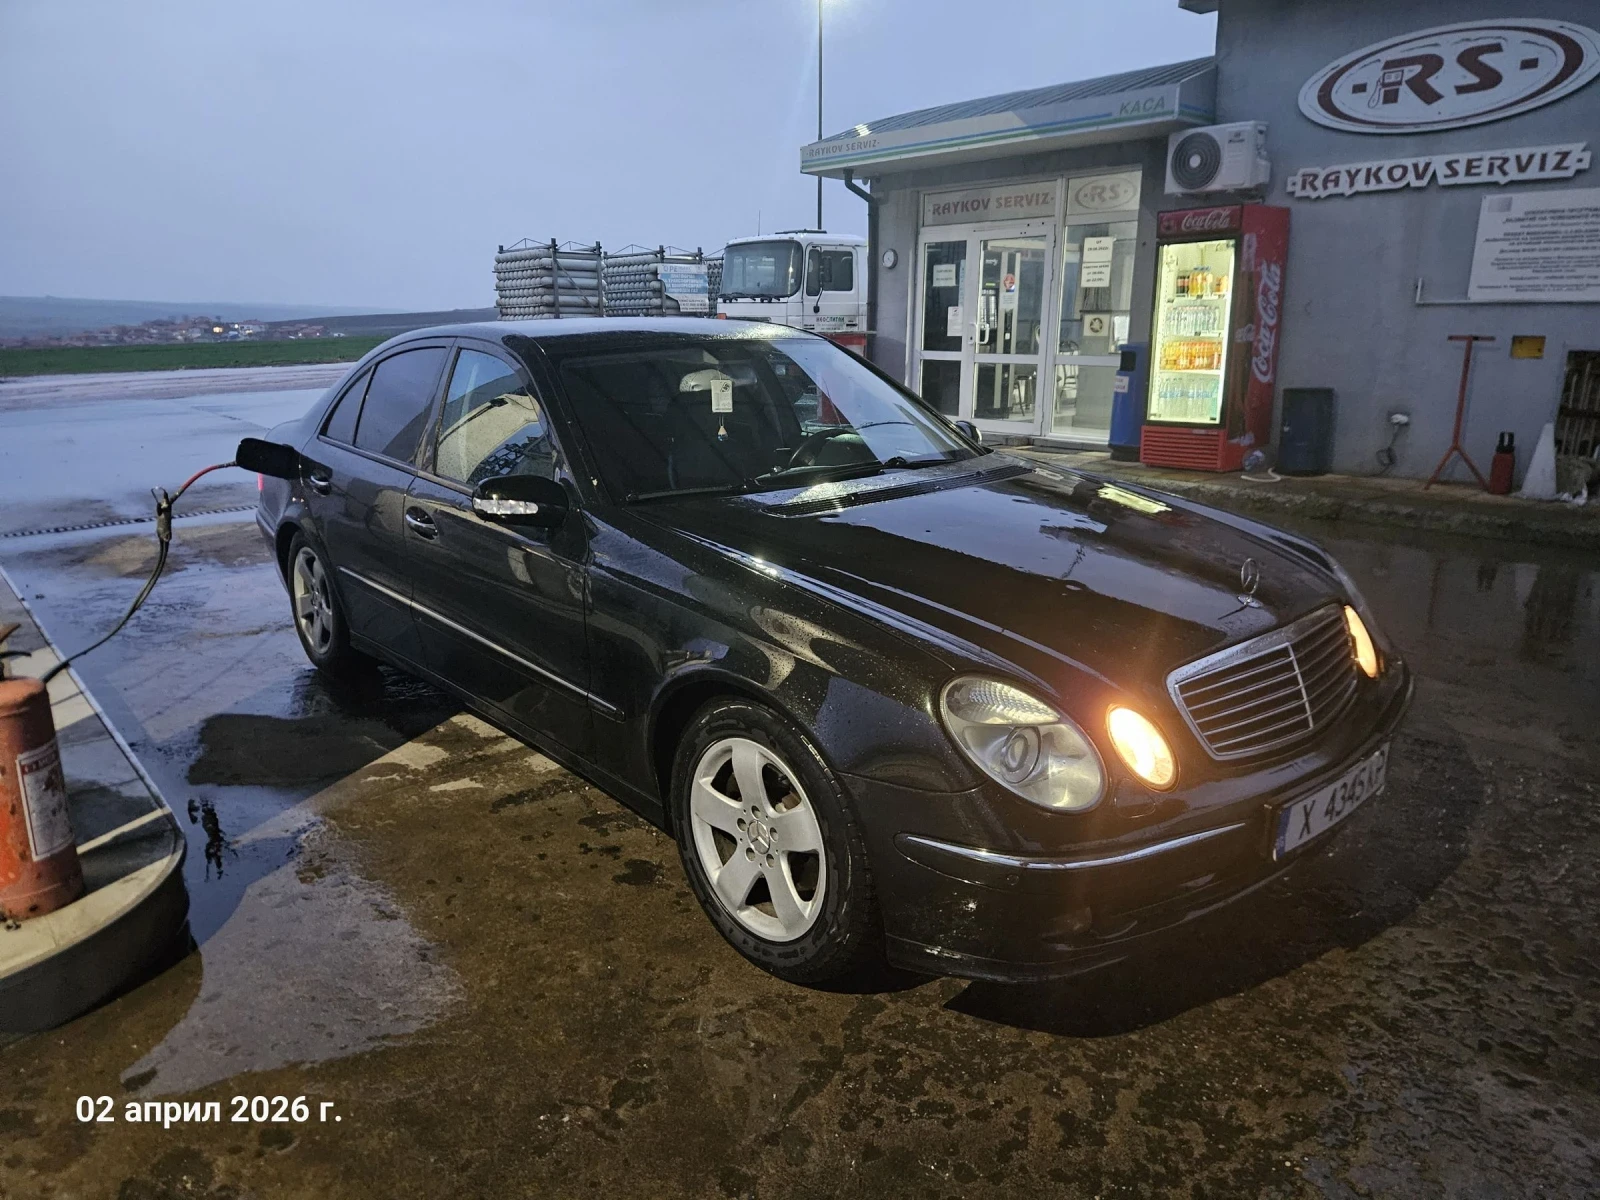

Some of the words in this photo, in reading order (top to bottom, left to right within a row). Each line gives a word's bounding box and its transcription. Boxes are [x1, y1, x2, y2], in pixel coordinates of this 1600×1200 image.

[1381, 42, 1505, 106] RS
[1119, 95, 1165, 116] КАСА
[808, 144, 844, 157] RAYKOV
[845, 139, 878, 151] SERVIZ
[1299, 160, 1433, 193] RAYKOV
[1442, 151, 1573, 179] SERVIZ
[931, 197, 991, 216] RAYKOV
[994, 191, 1051, 210] SERVIZ
[1089, 183, 1121, 204] RS
